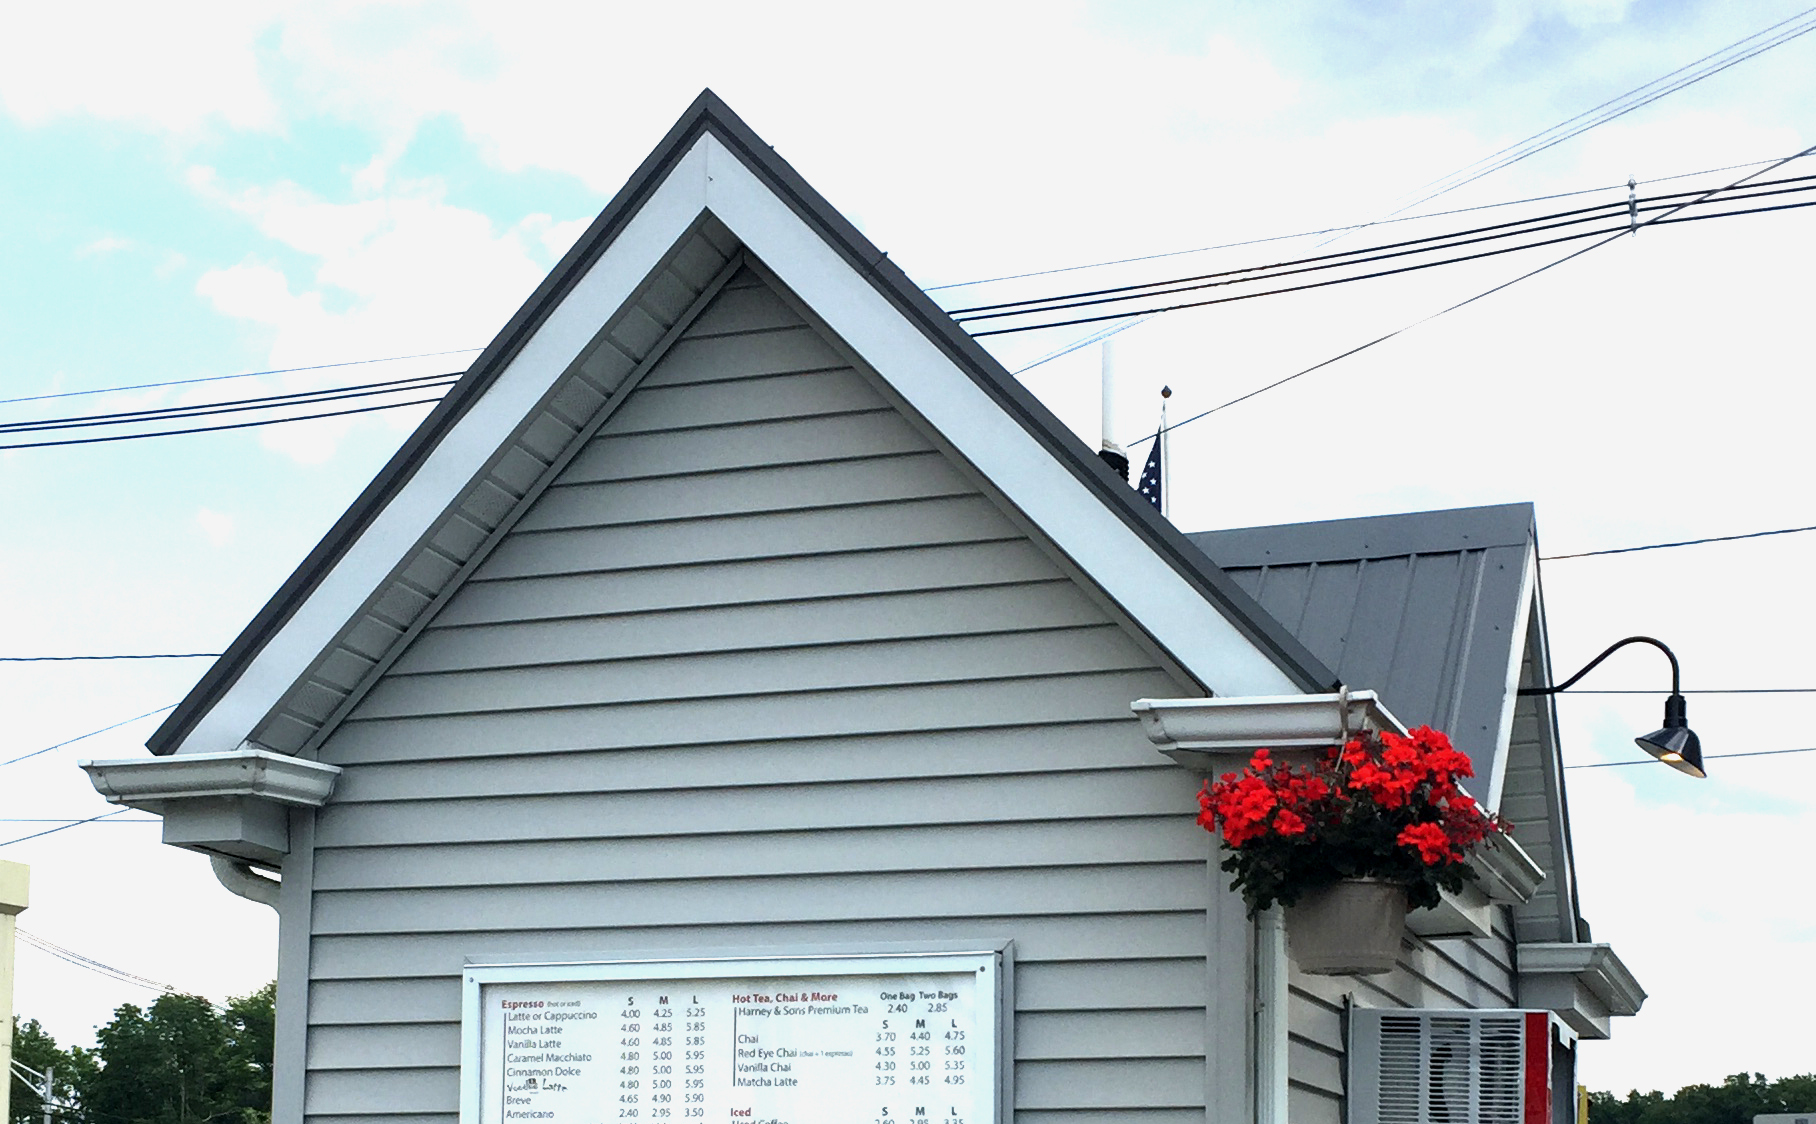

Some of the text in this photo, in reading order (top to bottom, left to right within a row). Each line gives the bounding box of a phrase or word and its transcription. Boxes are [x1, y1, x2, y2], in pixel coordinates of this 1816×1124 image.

[628, 995, 699, 1006] S M L
[732, 994, 751, 1004] Hot
[775, 993, 798, 1003] Chai
[800, 992, 809, 1002] &
[810, 992, 838, 1002] More
[880, 990, 958, 1002] One Bag Two Bags
[501, 1000, 544, 1011] Espresso
[738, 1004, 869, 1018] Harney & Sons Premium Tea
[888, 1002, 947, 1013] 2.40 2.85
[508, 1011, 598, 1022] Latte or Cappuccino
[621, 1007, 706, 1018] 4.00 4.25 5.25
[508, 1025, 563, 1035] Mocha Latte
[507, 1039, 562, 1049] Vanilla Latte
[738, 1034, 759, 1044] Chai
[507, 1052, 592, 1063] Caramel Macchiato
[738, 1048, 756, 1058] Red
[758, 1048, 774, 1060] Eye
[776, 1047, 797, 1058] Chai
[506, 1066, 581, 1077] Cinnamon Dolce
[738, 1062, 791, 1073] Vanilla Chai
[737, 1077, 798, 1087] Matcha Latte
[506, 1095, 532, 1105] Breve
[506, 1110, 555, 1119] Americano
[730, 1107, 751, 1117] Iced
